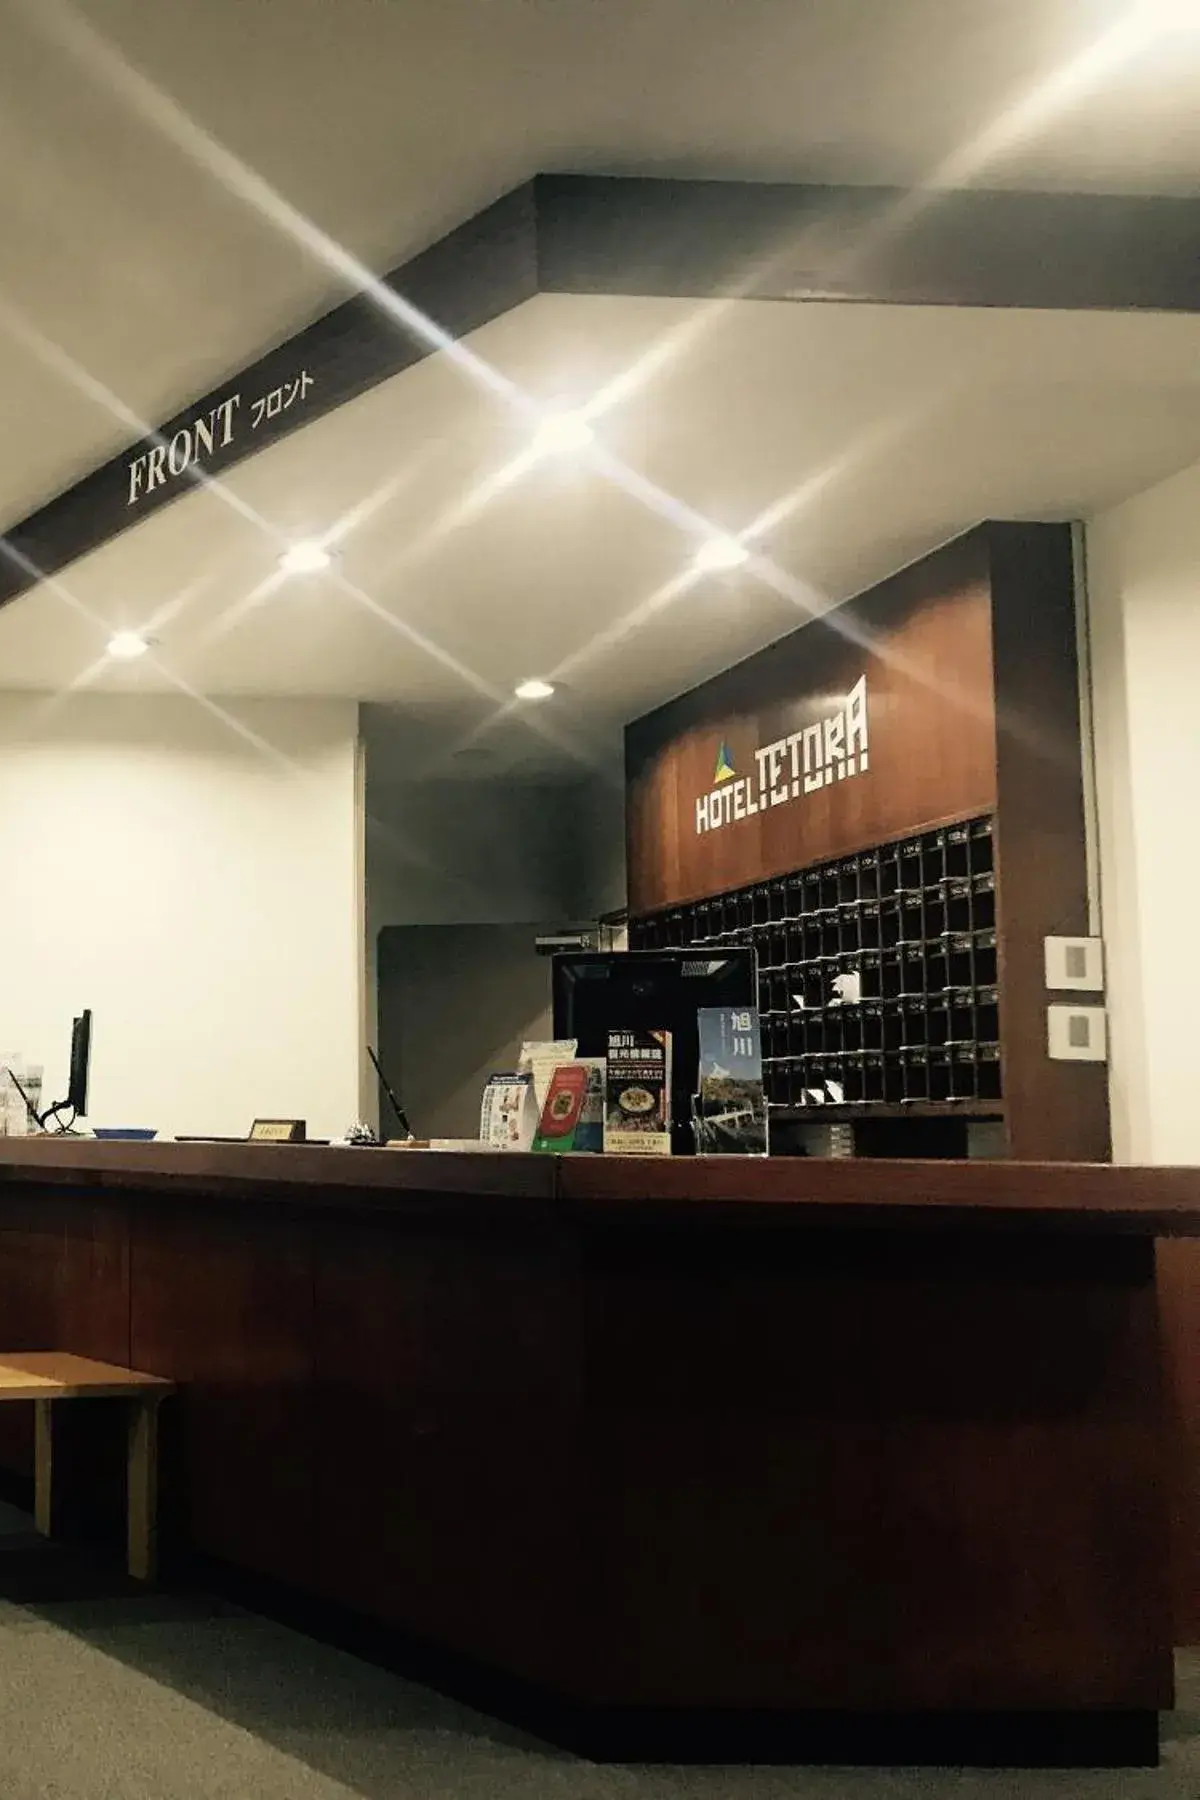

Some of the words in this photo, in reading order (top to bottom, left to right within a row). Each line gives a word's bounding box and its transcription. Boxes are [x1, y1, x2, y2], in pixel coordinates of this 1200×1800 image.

[127, 394, 241, 506] FRONT
[251, 370, 315, 429] フロント
[696, 776, 758, 835] HOTEL
[754, 674, 869, 811] TETORA
[731, 1011, 753, 1057] 旭川
